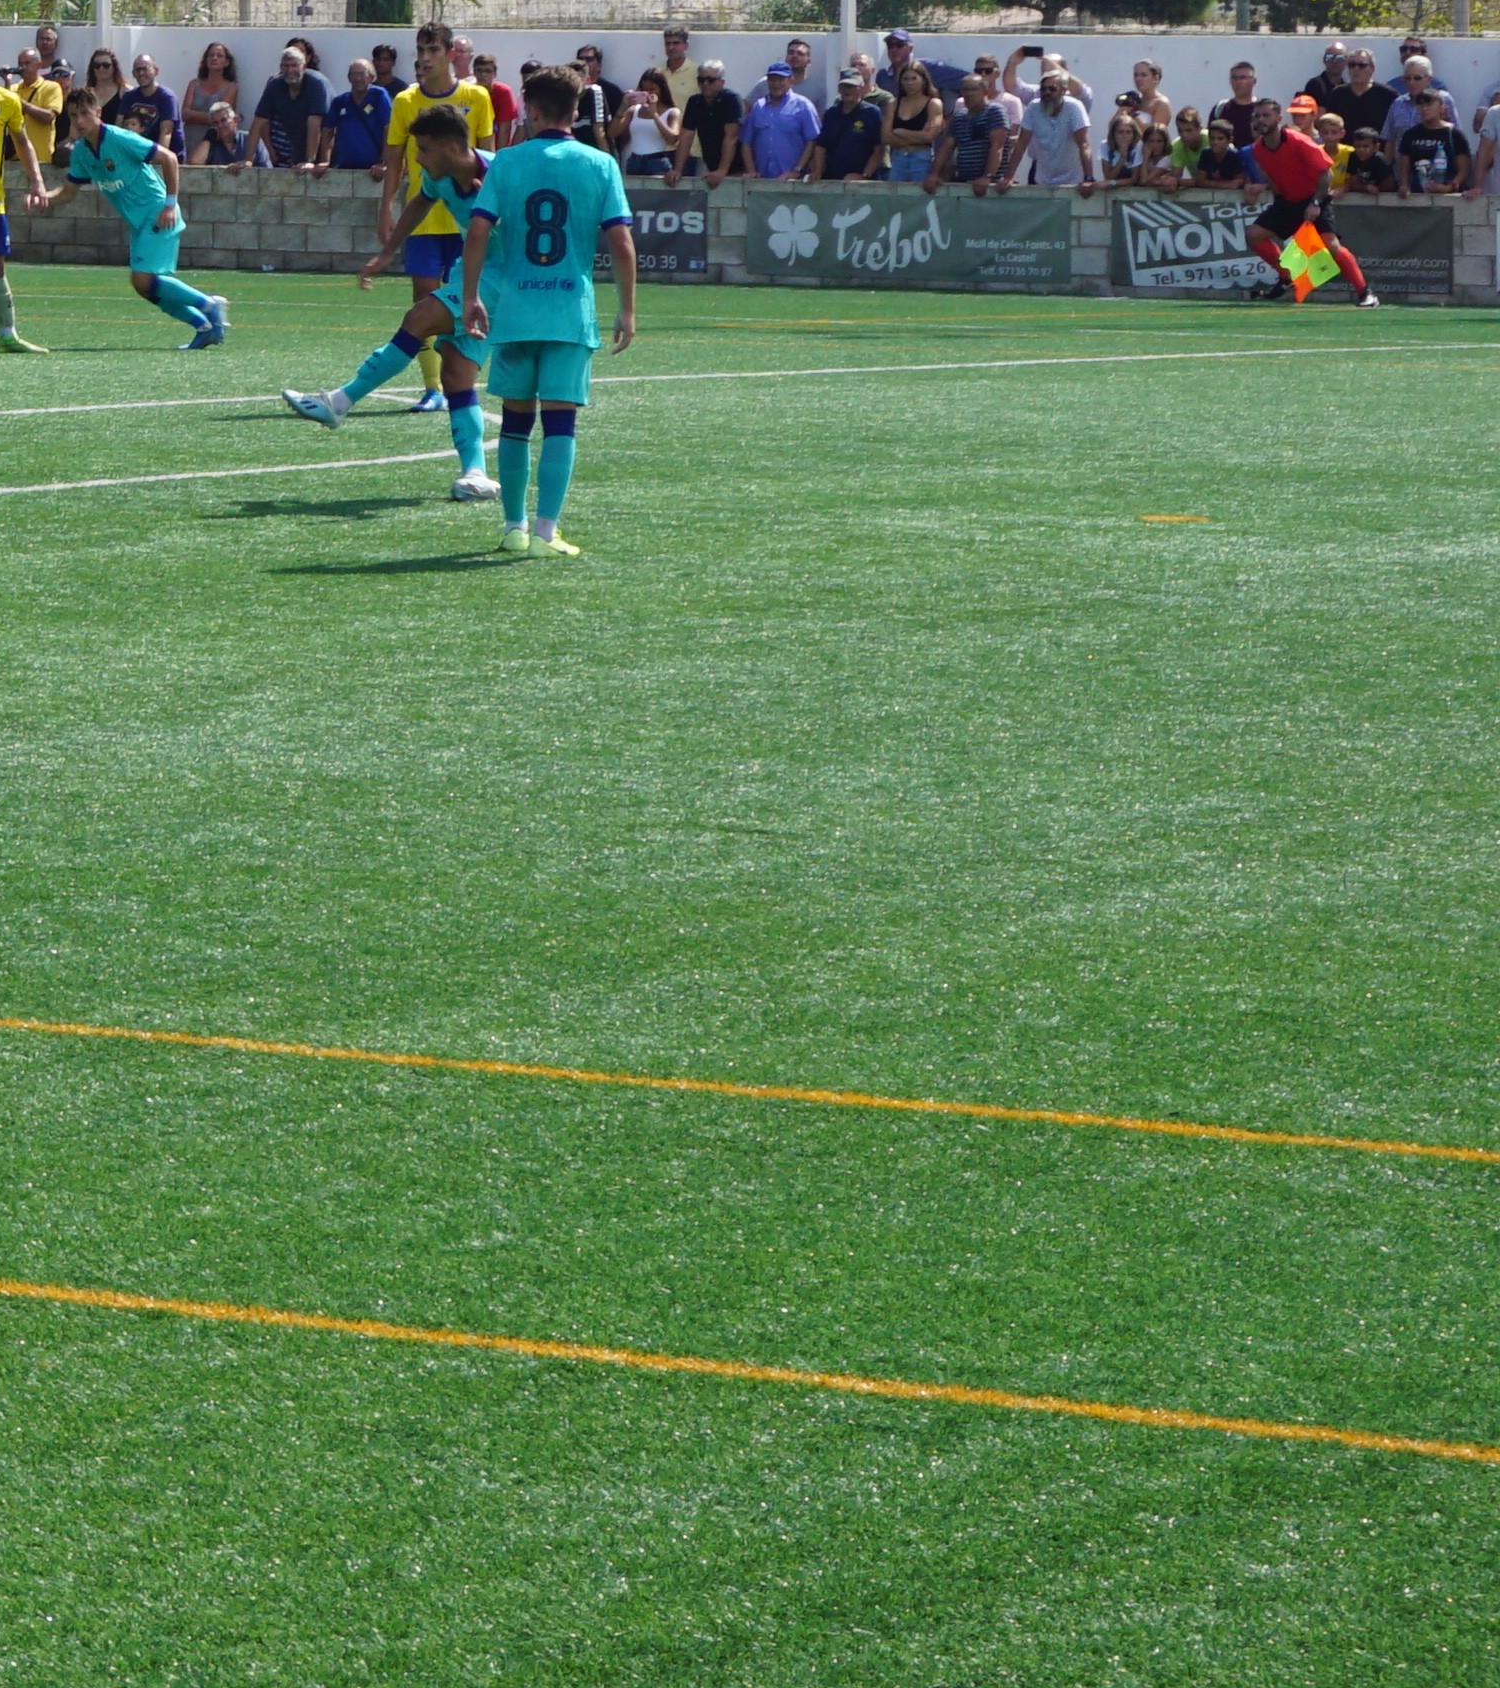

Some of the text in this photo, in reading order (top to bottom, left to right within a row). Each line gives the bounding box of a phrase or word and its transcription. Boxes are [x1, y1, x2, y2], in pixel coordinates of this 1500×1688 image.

[525, 188, 568, 267] 8
[832, 198, 951, 273] Trébol
[638, 255, 656, 268] 50
[659, 255, 678, 269] 39
[1151, 261, 1267, 286] Tel. 971 36 26
[517, 277, 559, 291] unicef
